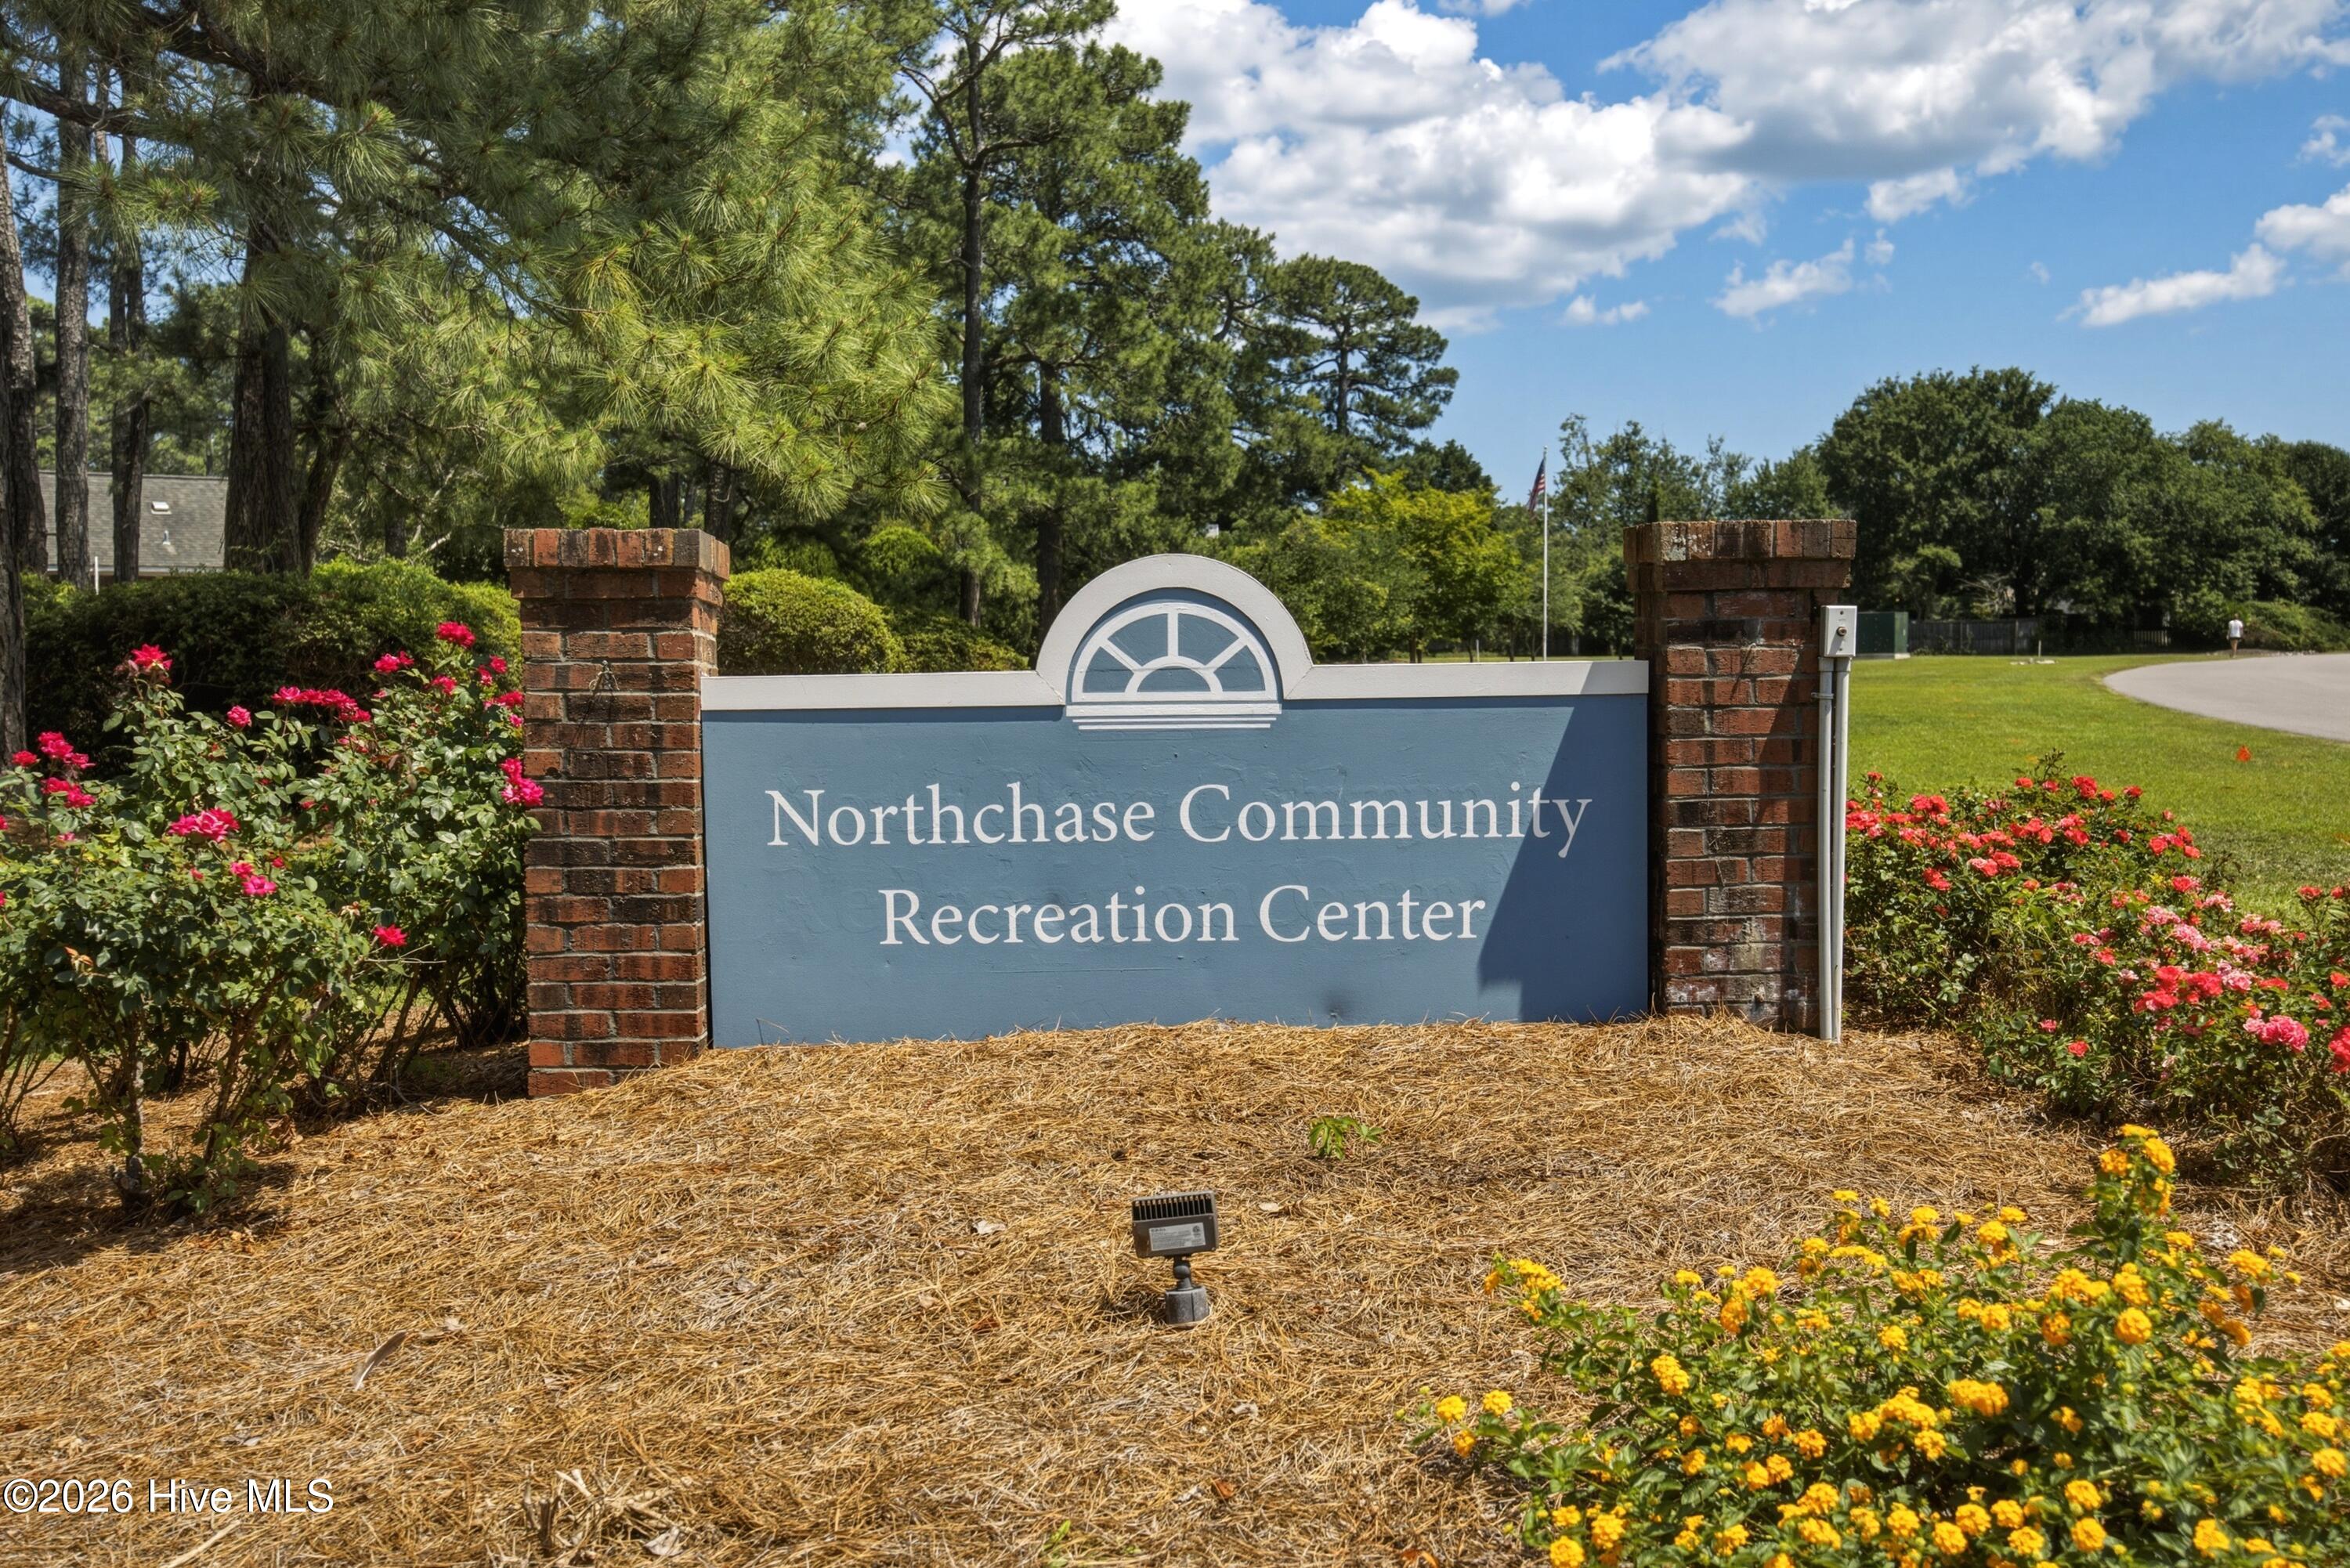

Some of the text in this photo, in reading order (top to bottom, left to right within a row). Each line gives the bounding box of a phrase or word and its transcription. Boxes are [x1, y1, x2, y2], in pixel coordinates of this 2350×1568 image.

[765, 782, 1592, 858] Northchase Community
[878, 885, 1486, 945] Recreation Center
